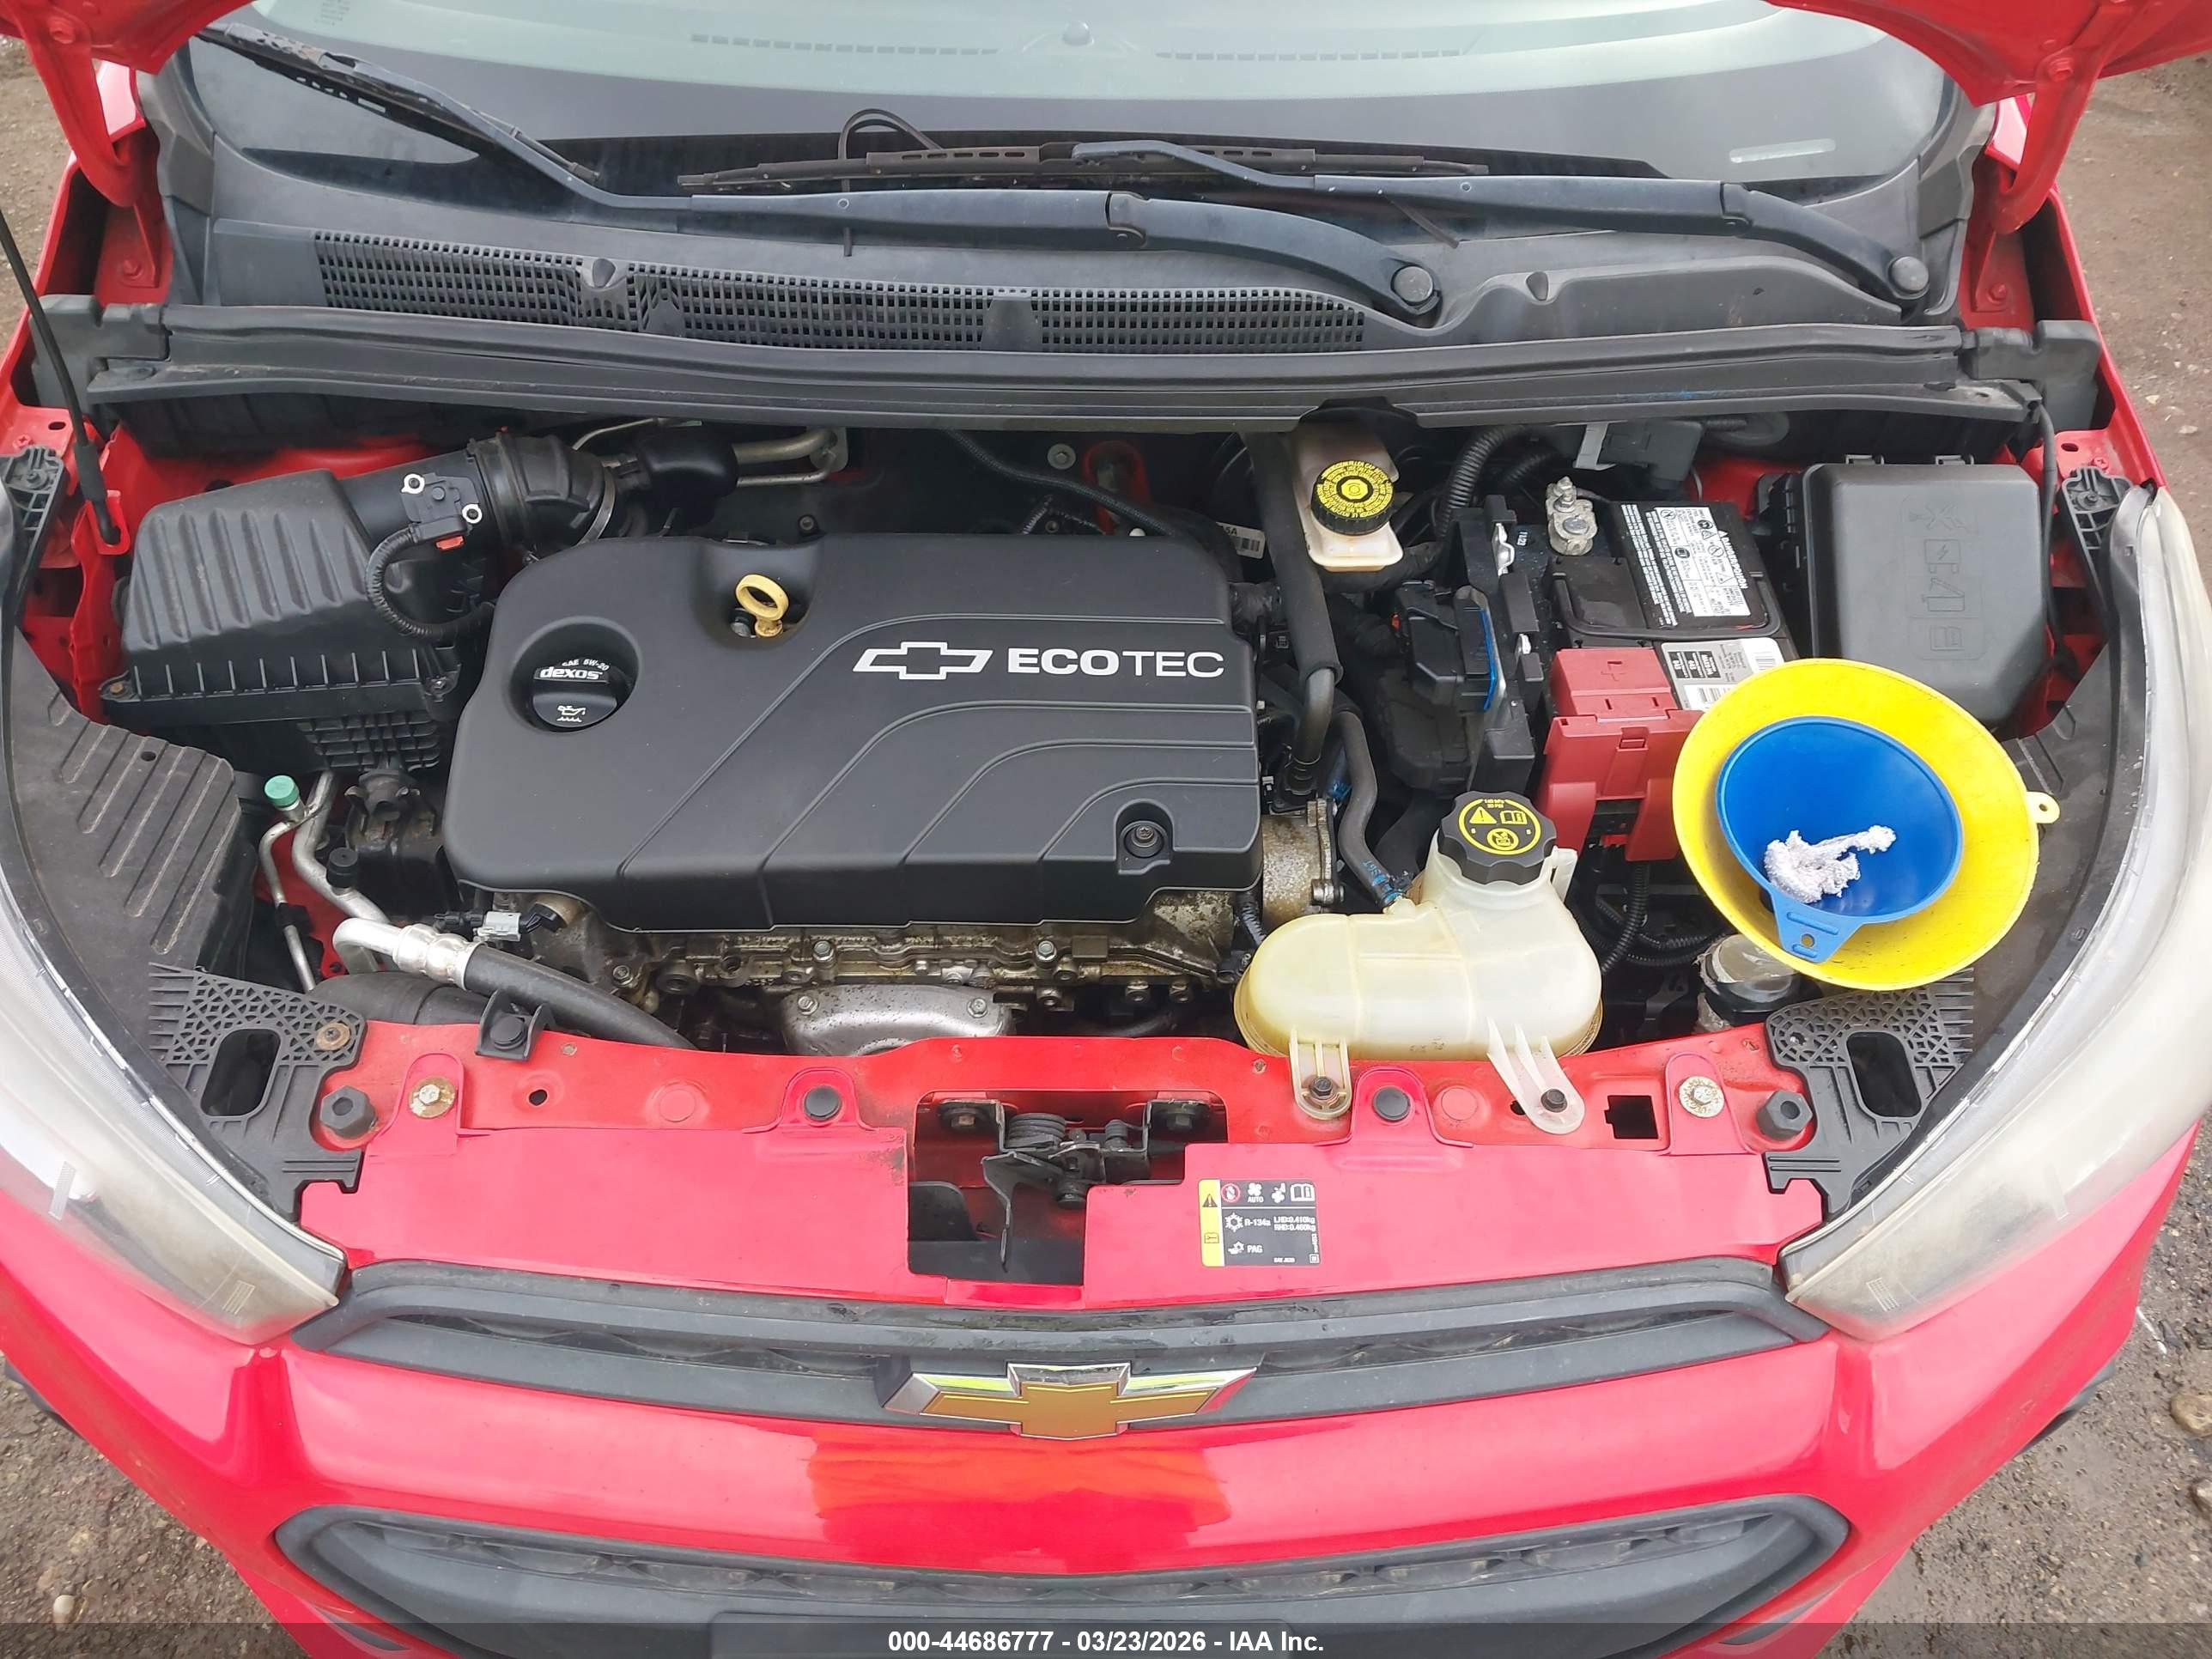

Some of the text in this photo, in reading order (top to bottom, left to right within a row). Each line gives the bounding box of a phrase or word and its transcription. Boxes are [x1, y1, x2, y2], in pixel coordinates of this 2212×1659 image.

[1007, 647, 1224, 678] ECOTEC
[539, 665, 603, 680] dexos
[1247, 1195, 1264, 1204] AUTO
[1246, 1244, 1263, 1254] PAG
